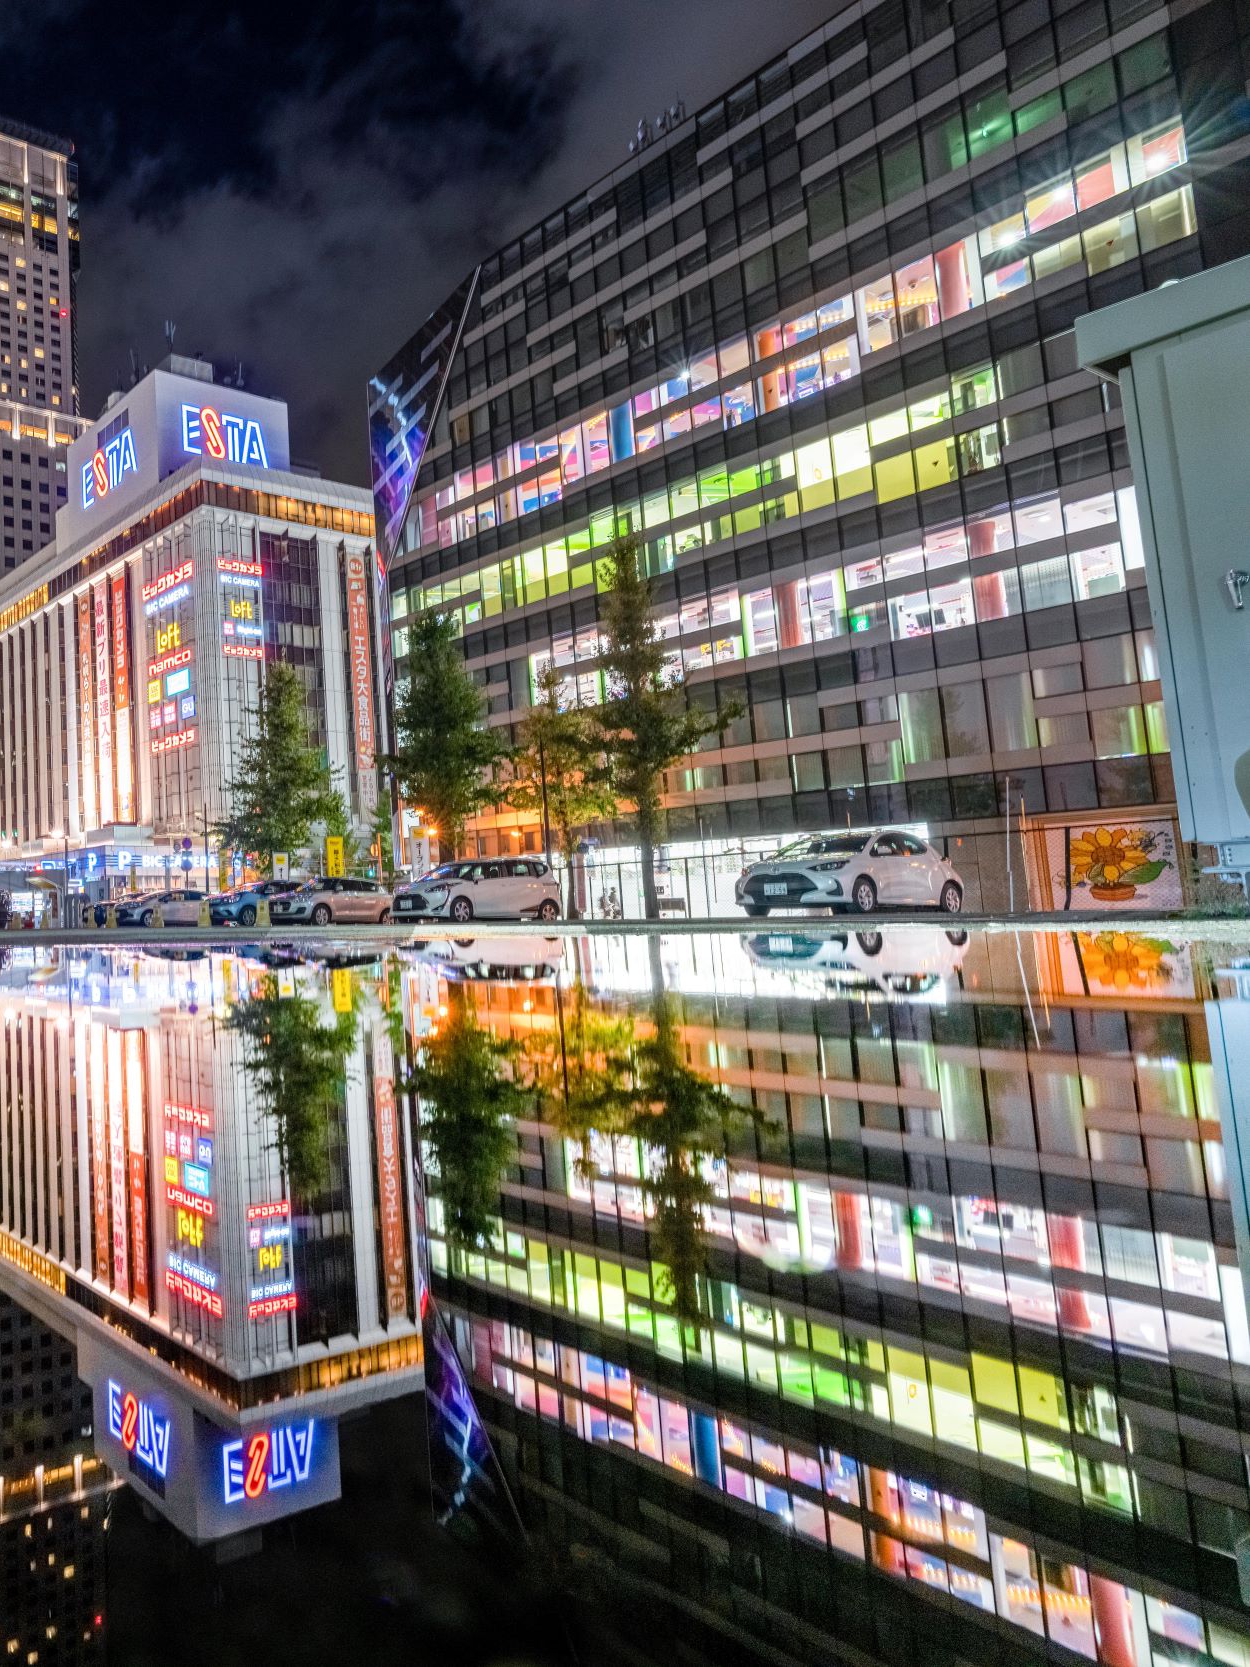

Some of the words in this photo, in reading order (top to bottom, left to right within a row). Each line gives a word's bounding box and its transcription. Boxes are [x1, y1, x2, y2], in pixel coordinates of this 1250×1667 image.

[181, 404, 269, 470] ESTA
[81, 428, 138, 510] ESTA
[217, 559, 263, 575] ビックカメラ
[142, 561, 193, 600] ビックカメラ
[233, 576, 260, 587] CAMERA
[159, 585, 189, 608] CAMERA
[231, 600, 252, 619] Loft
[156, 621, 180, 654] Loft
[223, 645, 263, 657] ビックカメラ
[148, 650, 191, 676] namco
[355, 636, 371, 742] エスタ大食品街
[181, 701, 194, 714] GU
[151, 729, 195, 753] ビックカメラ
[88, 852, 97, 872] P
[118, 851, 132, 871] P
[142, 855, 164, 867] BIC
